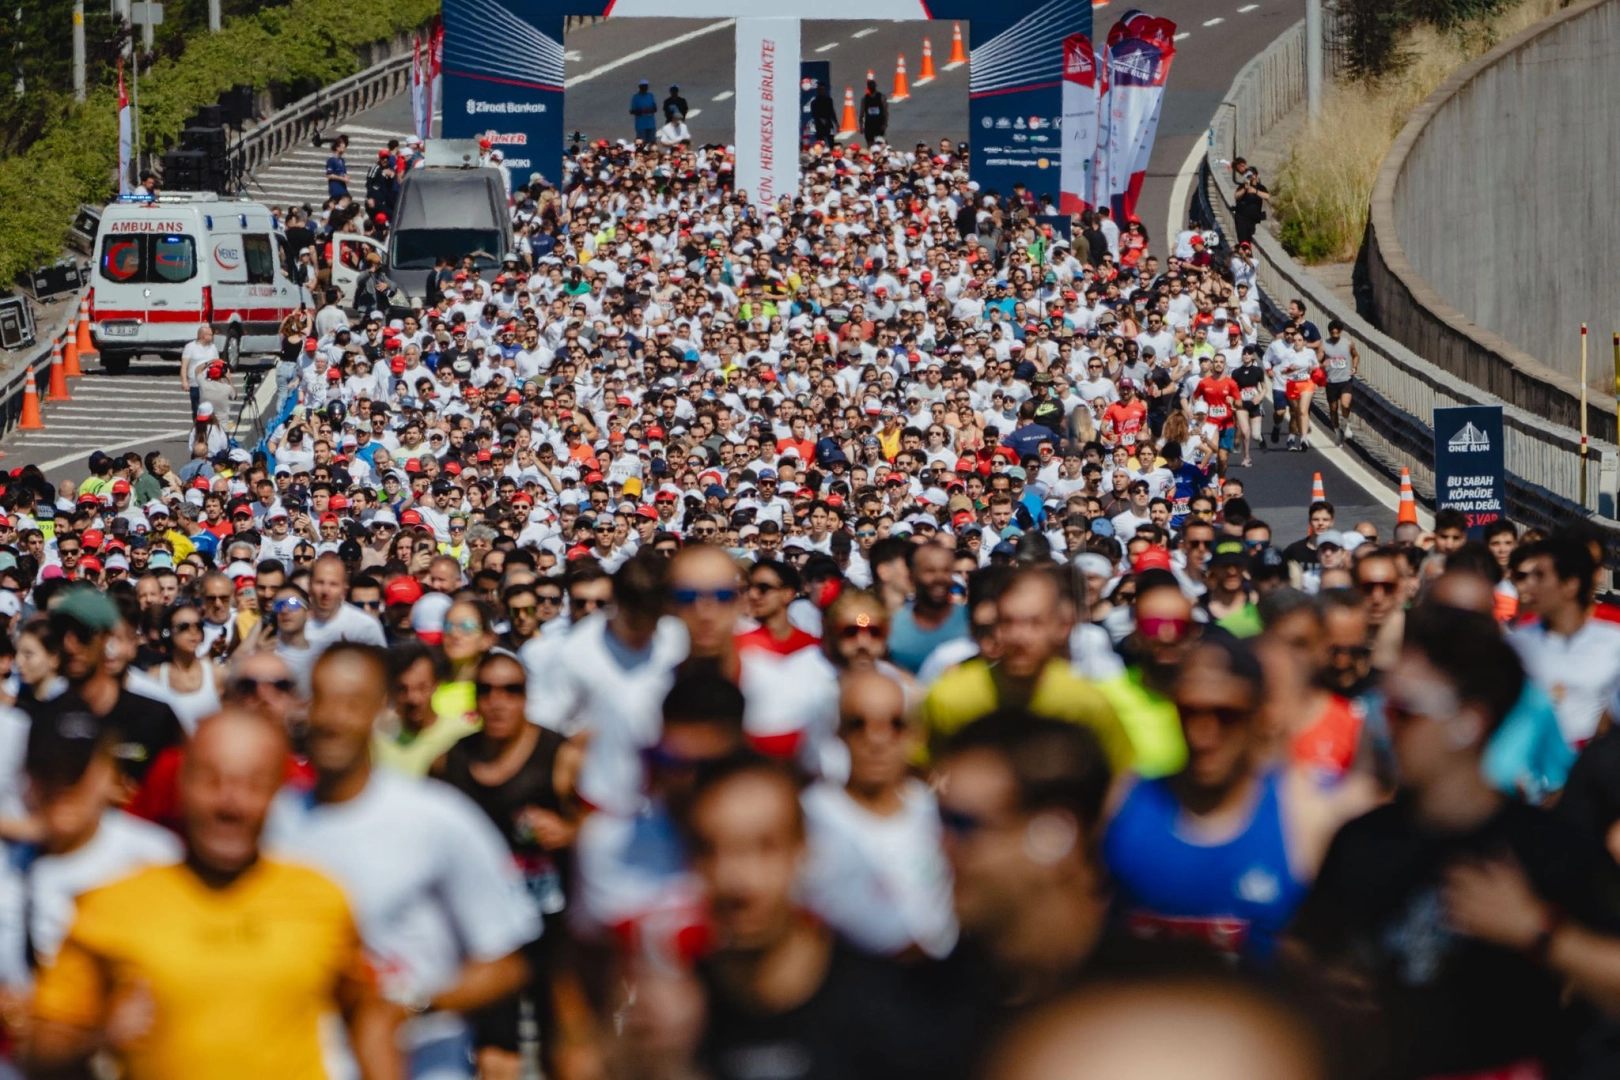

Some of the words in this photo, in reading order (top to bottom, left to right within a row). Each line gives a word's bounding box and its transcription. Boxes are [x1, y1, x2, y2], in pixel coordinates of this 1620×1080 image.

[758, 38, 775, 102] BİRLİKTE!
[476, 101, 506, 113] Ziraat
[760, 104, 774, 171] HERKESLE
[111, 221, 184, 232] AMBULANS
[1448, 444, 1469, 453] ONE
[1470, 443, 1490, 452] RUN
[1447, 476, 1462, 487] BU
[1463, 475, 1494, 487] SABAH
[1448, 488, 1494, 500] KÖPRÜDE
[1475, 498, 1501, 511] DEĞİL
